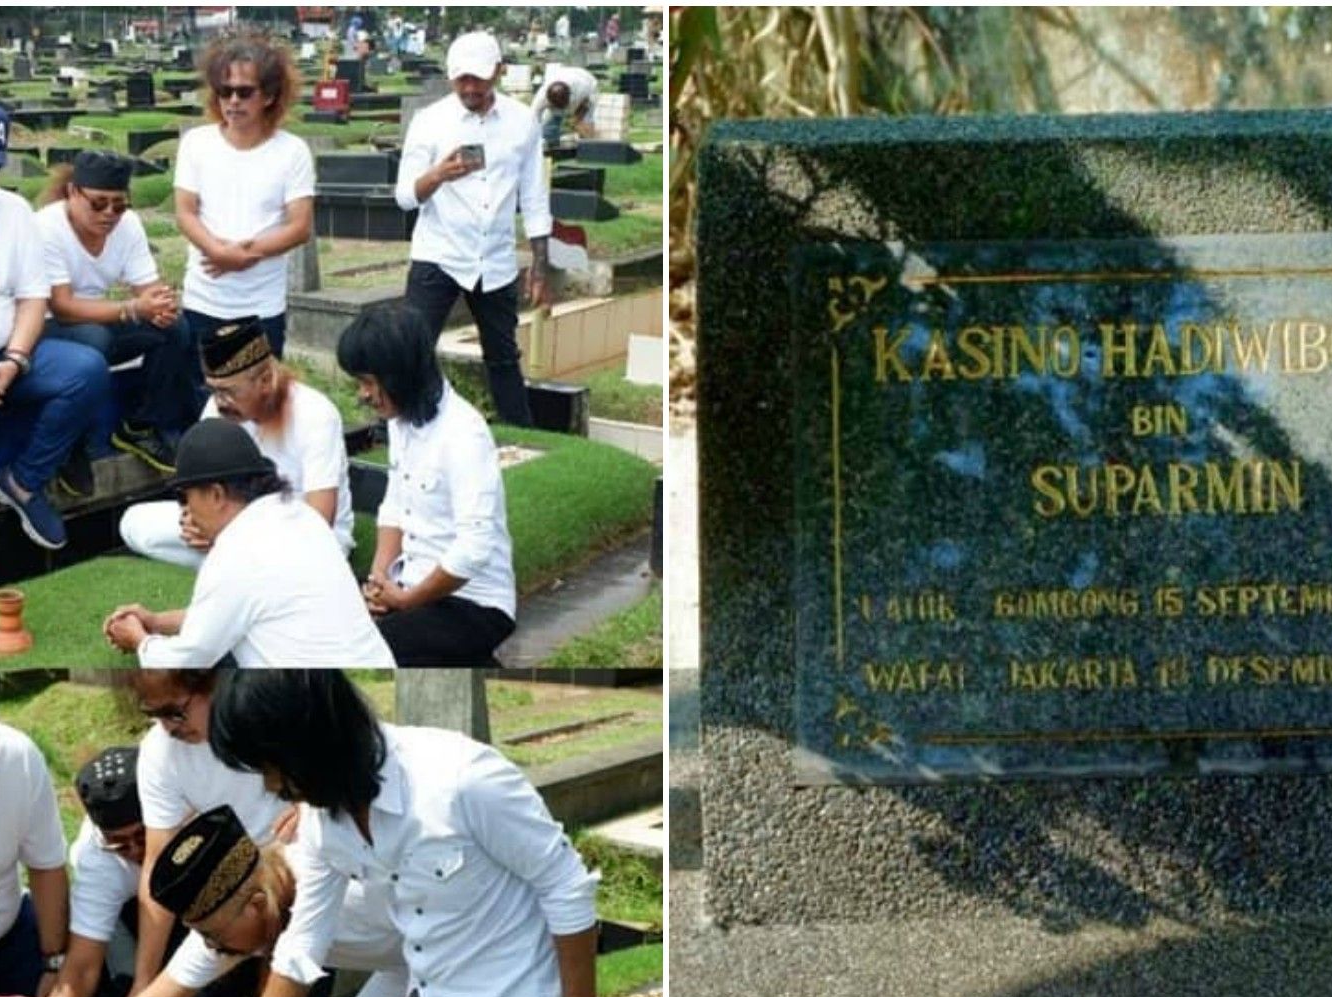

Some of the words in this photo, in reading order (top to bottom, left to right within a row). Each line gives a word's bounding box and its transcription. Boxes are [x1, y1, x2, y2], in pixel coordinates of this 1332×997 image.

[873, 322, 1080, 384] KASINO
[1132, 404, 1187, 437] BIN
[1031, 457, 1303, 518] SUPARMIN
[1153, 586, 1186, 617] 15
